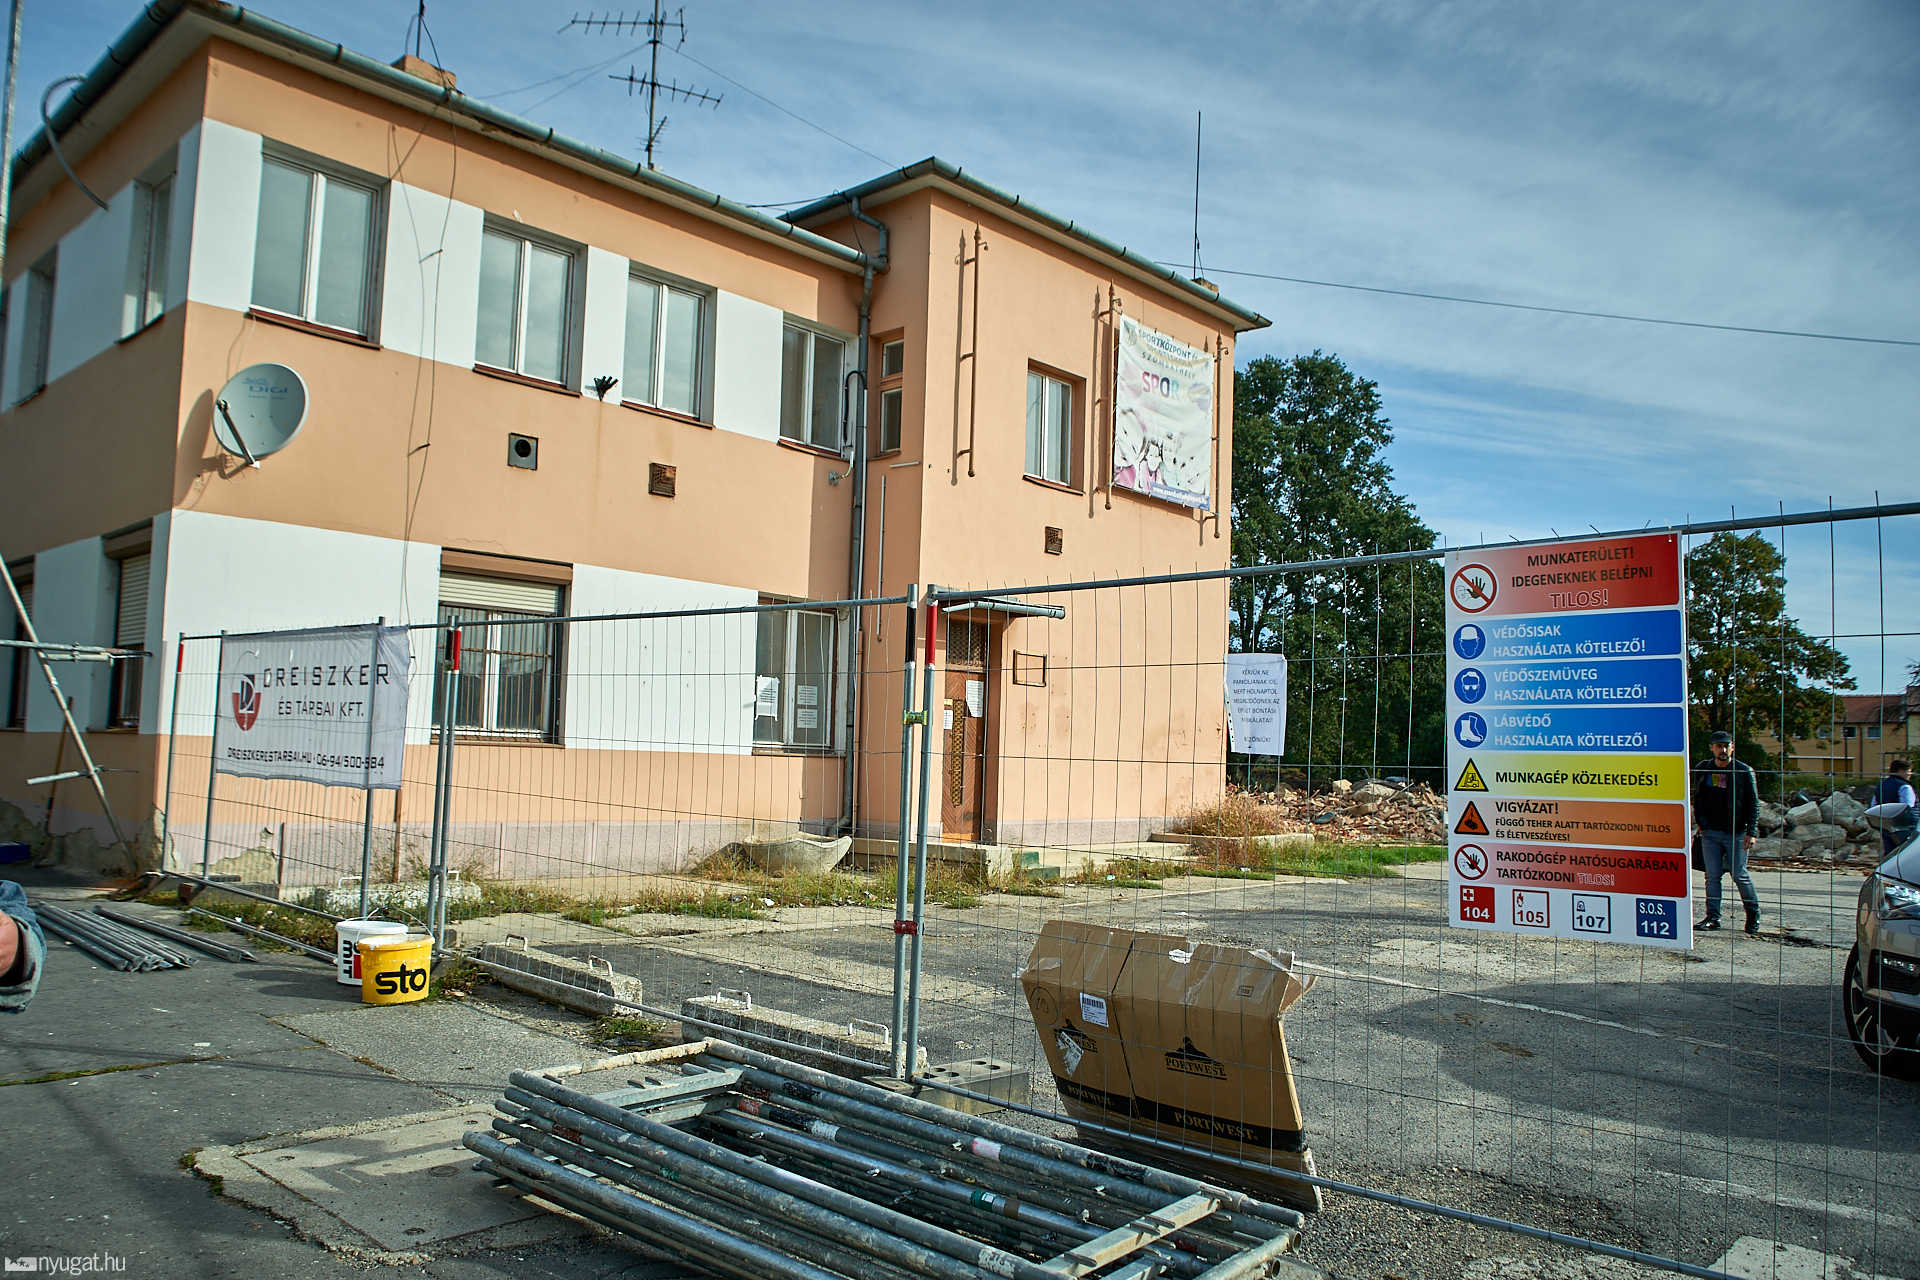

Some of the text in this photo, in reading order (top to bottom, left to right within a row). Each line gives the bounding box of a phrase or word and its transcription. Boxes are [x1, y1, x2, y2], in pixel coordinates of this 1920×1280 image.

[1527, 546, 1635, 567] MUNKATERÜLET!
[1511, 564, 1653, 588] IDEGENEKNEK BELÉPNI
[1550, 588, 1609, 609] TILOS!
[1492, 623, 1561, 639] VÉDŐSISAK
[1493, 638, 1646, 657] HASZNÁLATA KÖTELEZŐ!
[263, 663, 390, 688] DREISZKER
[1494, 667, 1598, 682] VÉDŐSZEMÜVEG
[1494, 683, 1648, 701] HASZNÁLATA KÖTELEZŐ!
[278, 695, 364, 717] ÉS TÁRSAI KFT.
[1494, 713, 1552, 728] LÁBVÉDŐ
[1495, 731, 1648, 747] HASZNÁLATA KÖTELEZŐ!
[1495, 770, 1659, 786] MUNKAGÉP KÖZLEKEDÉS!
[1495, 799, 1559, 814] VIGYÁZAT!
[1526, 819, 1553, 828] TEHER
[1555, 820, 1580, 830] ALATT
[1582, 820, 1644, 832] TARTÓZKODNI
[1646, 824, 1671, 834] TILOS
[1495, 829, 1570, 842] ÉS ÉLETVESZÉLYES!
[1496, 850, 1679, 872] RAKODÓGÉP HATÓSUGARÁBAN
[1497, 867, 1615, 887] TARTÓZKODNI TILOS!
[1463, 907, 1490, 920] 104
[1517, 910, 1544, 924] 105
[1639, 902, 1666, 916] S.O.S.
[1576, 914, 1605, 928] 107
[1640, 921, 1670, 936] 112
[375, 961, 427, 995] sto
[1165, 1057, 1227, 1077] PORTWEST
[1174, 1111, 1256, 1141] PORTWEST
